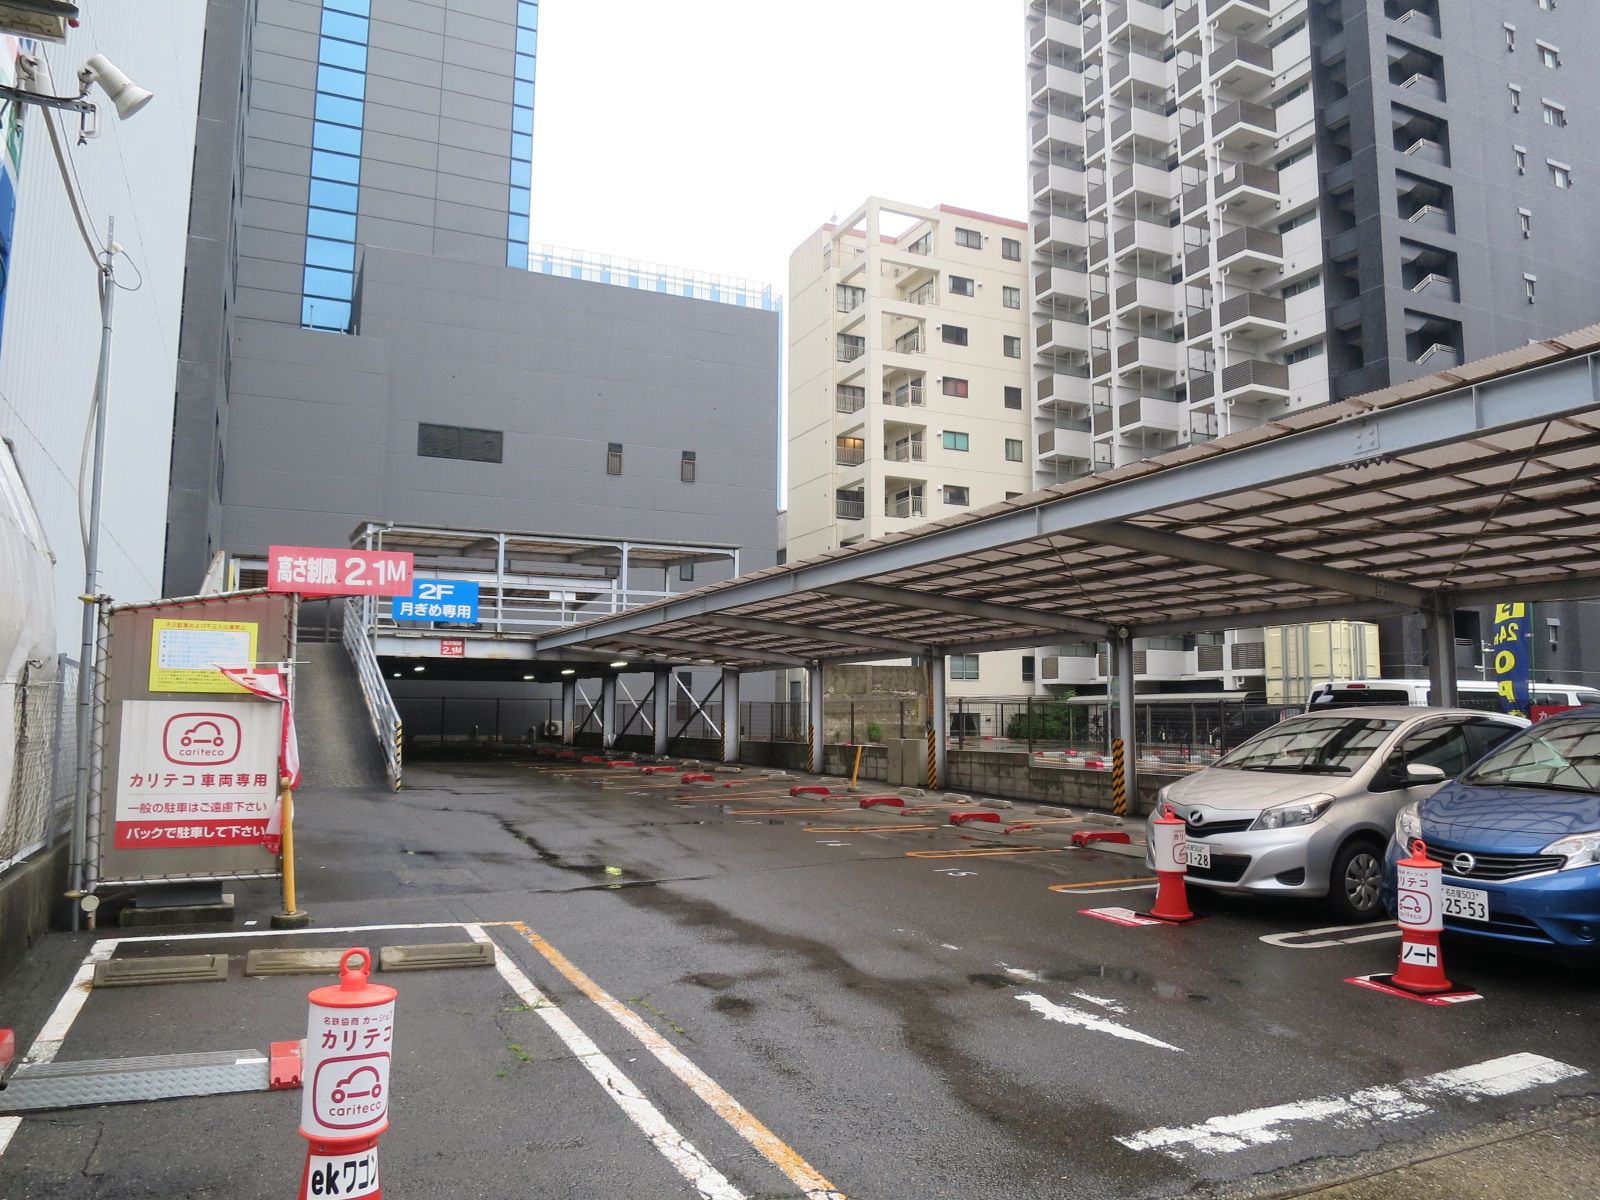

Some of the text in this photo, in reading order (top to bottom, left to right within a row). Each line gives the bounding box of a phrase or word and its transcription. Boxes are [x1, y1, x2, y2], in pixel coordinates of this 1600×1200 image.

[277, 556, 406, 586] 高さ制限 2.1M
[418, 583, 455, 600] 2F
[400, 602, 472, 619] 月ぎめ専用
[442, 646, 463, 655] 2.1M
[179, 748, 224, 756] cariteco
[127, 802, 267, 814] 一般の駐車はご遠慮下さい
[126, 825, 265, 840] バックで駐車して下さい
[1399, 876, 1429, 888] リテコ
[1445, 898, 1486, 919] 25-53
[1403, 945, 1436, 964] ノート
[323, 1016, 360, 1026] 名鉄協商
[321, 1025, 392, 1051] カリテコ
[329, 1101, 382, 1117] cariteco
